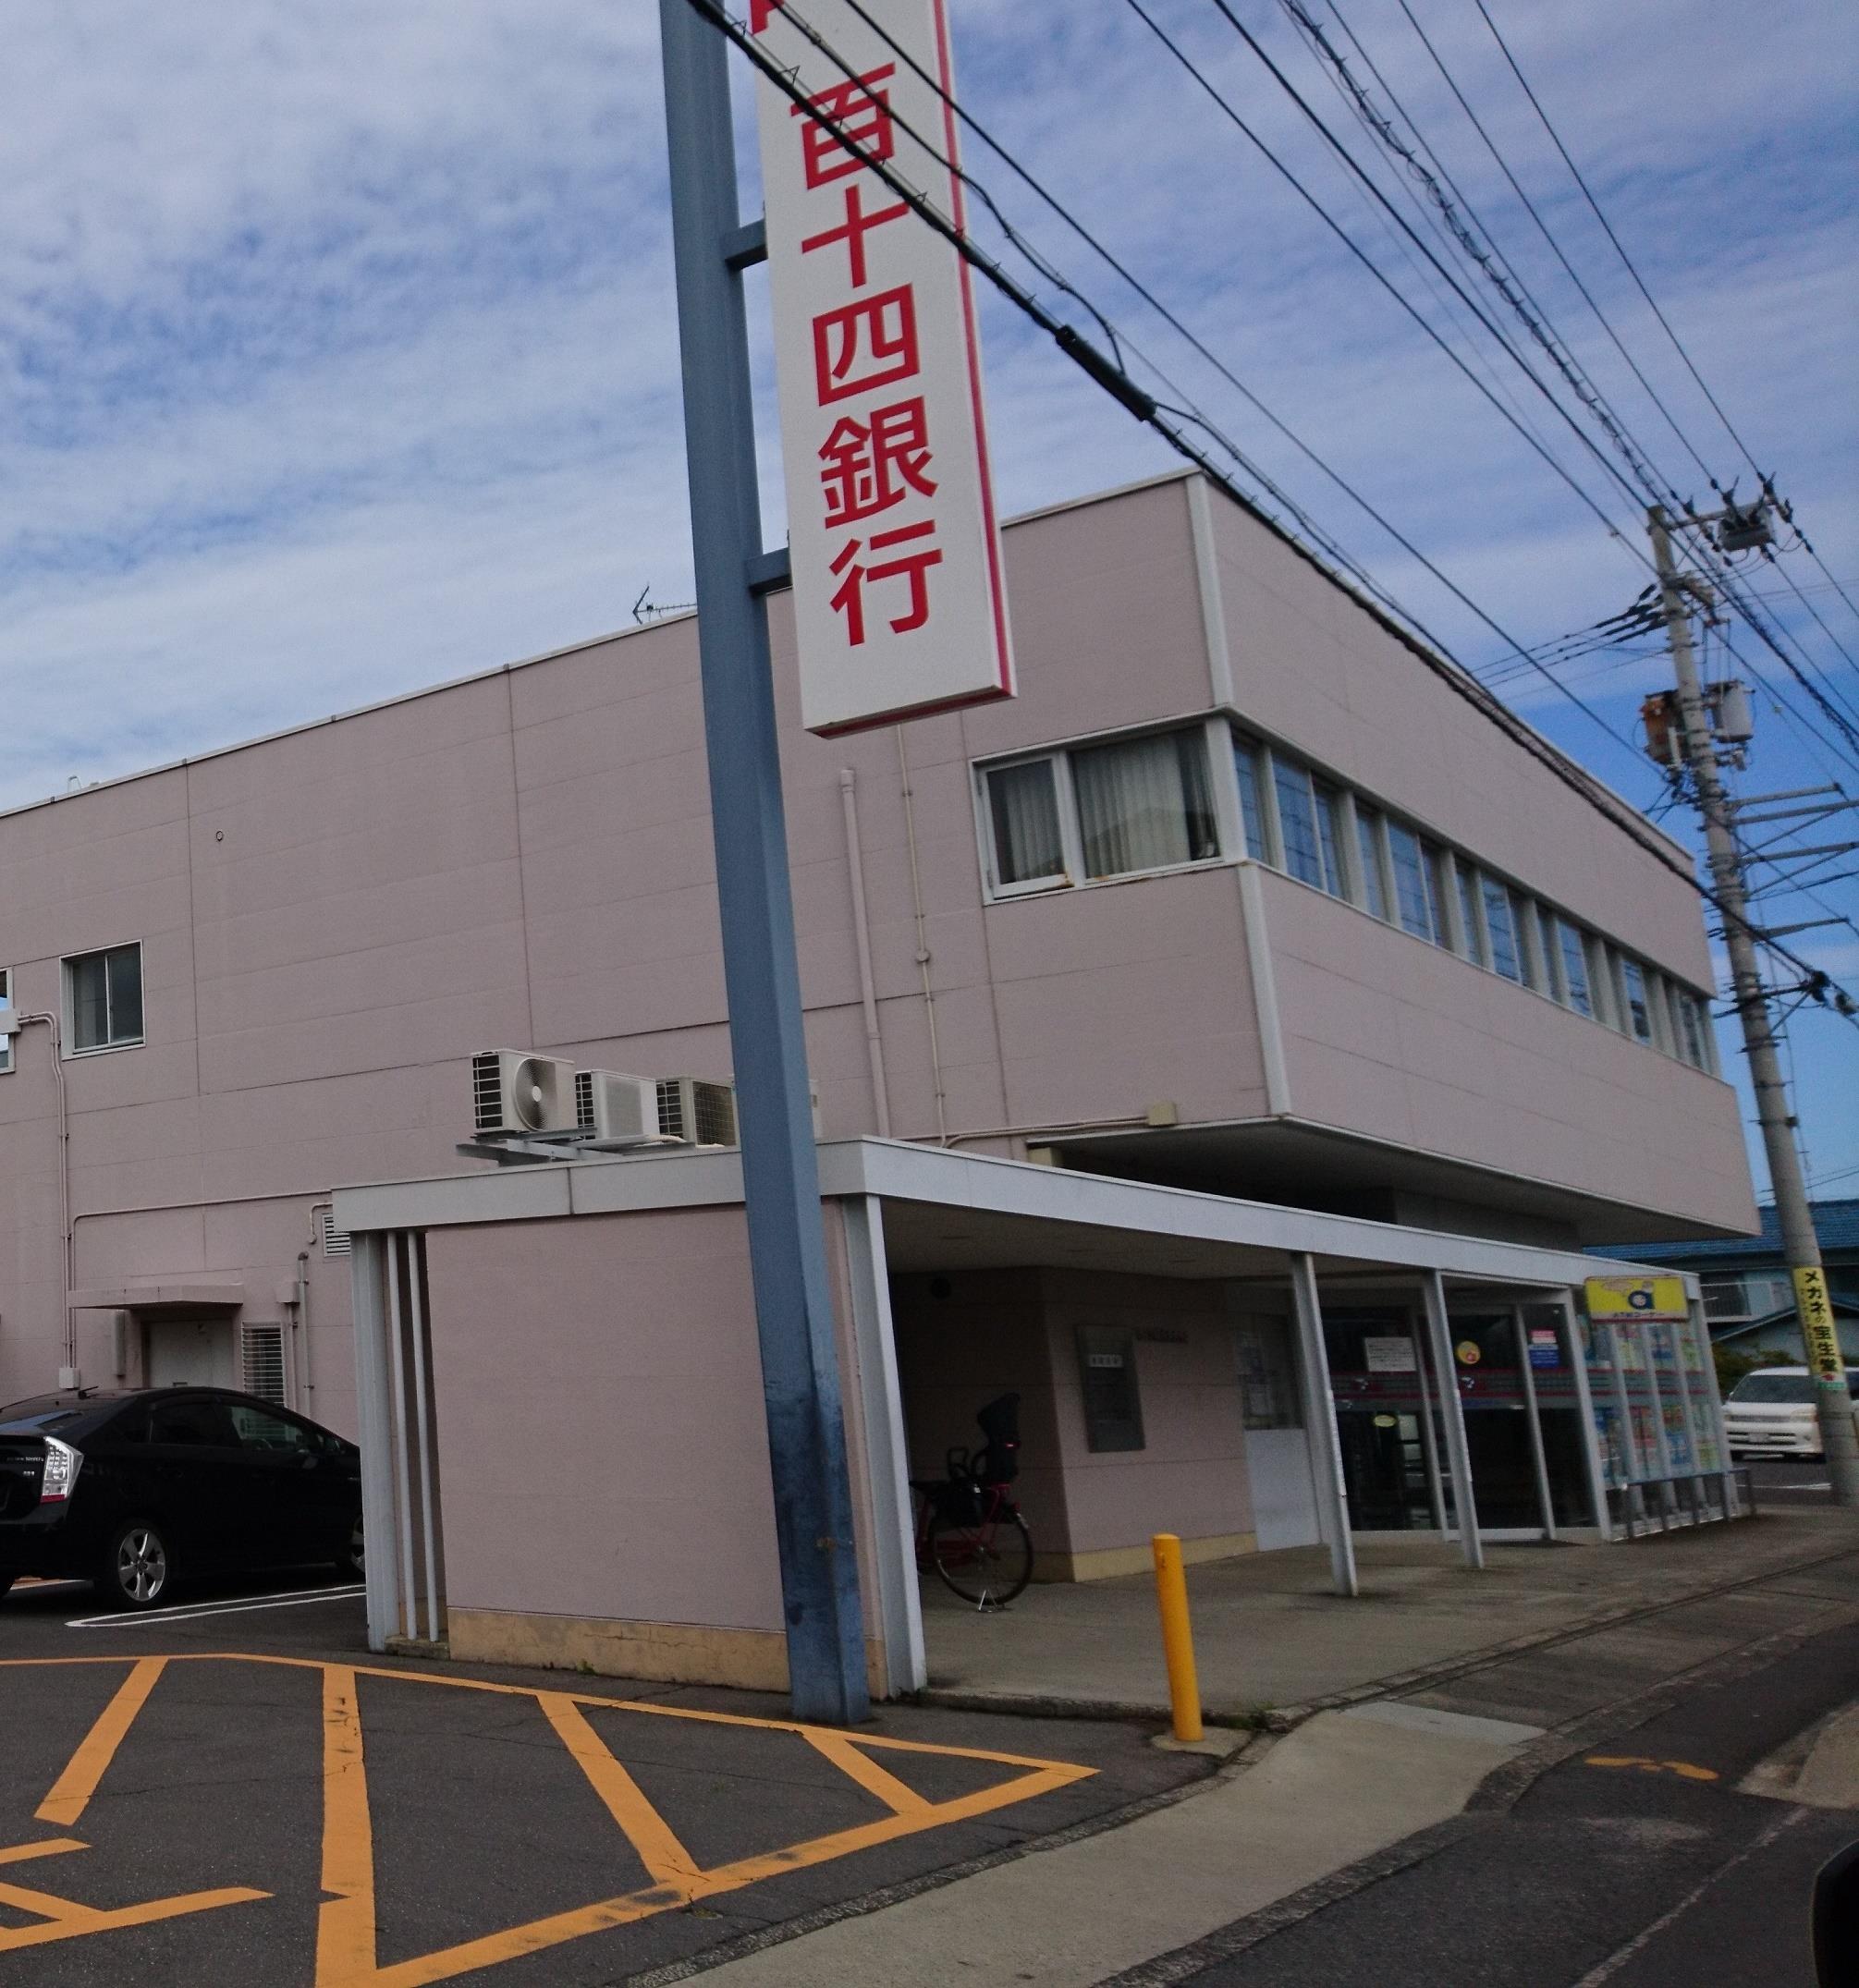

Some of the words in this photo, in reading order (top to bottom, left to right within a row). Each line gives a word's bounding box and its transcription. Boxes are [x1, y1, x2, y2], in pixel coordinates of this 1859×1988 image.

[790, 62, 943, 646] 百十四銀行
